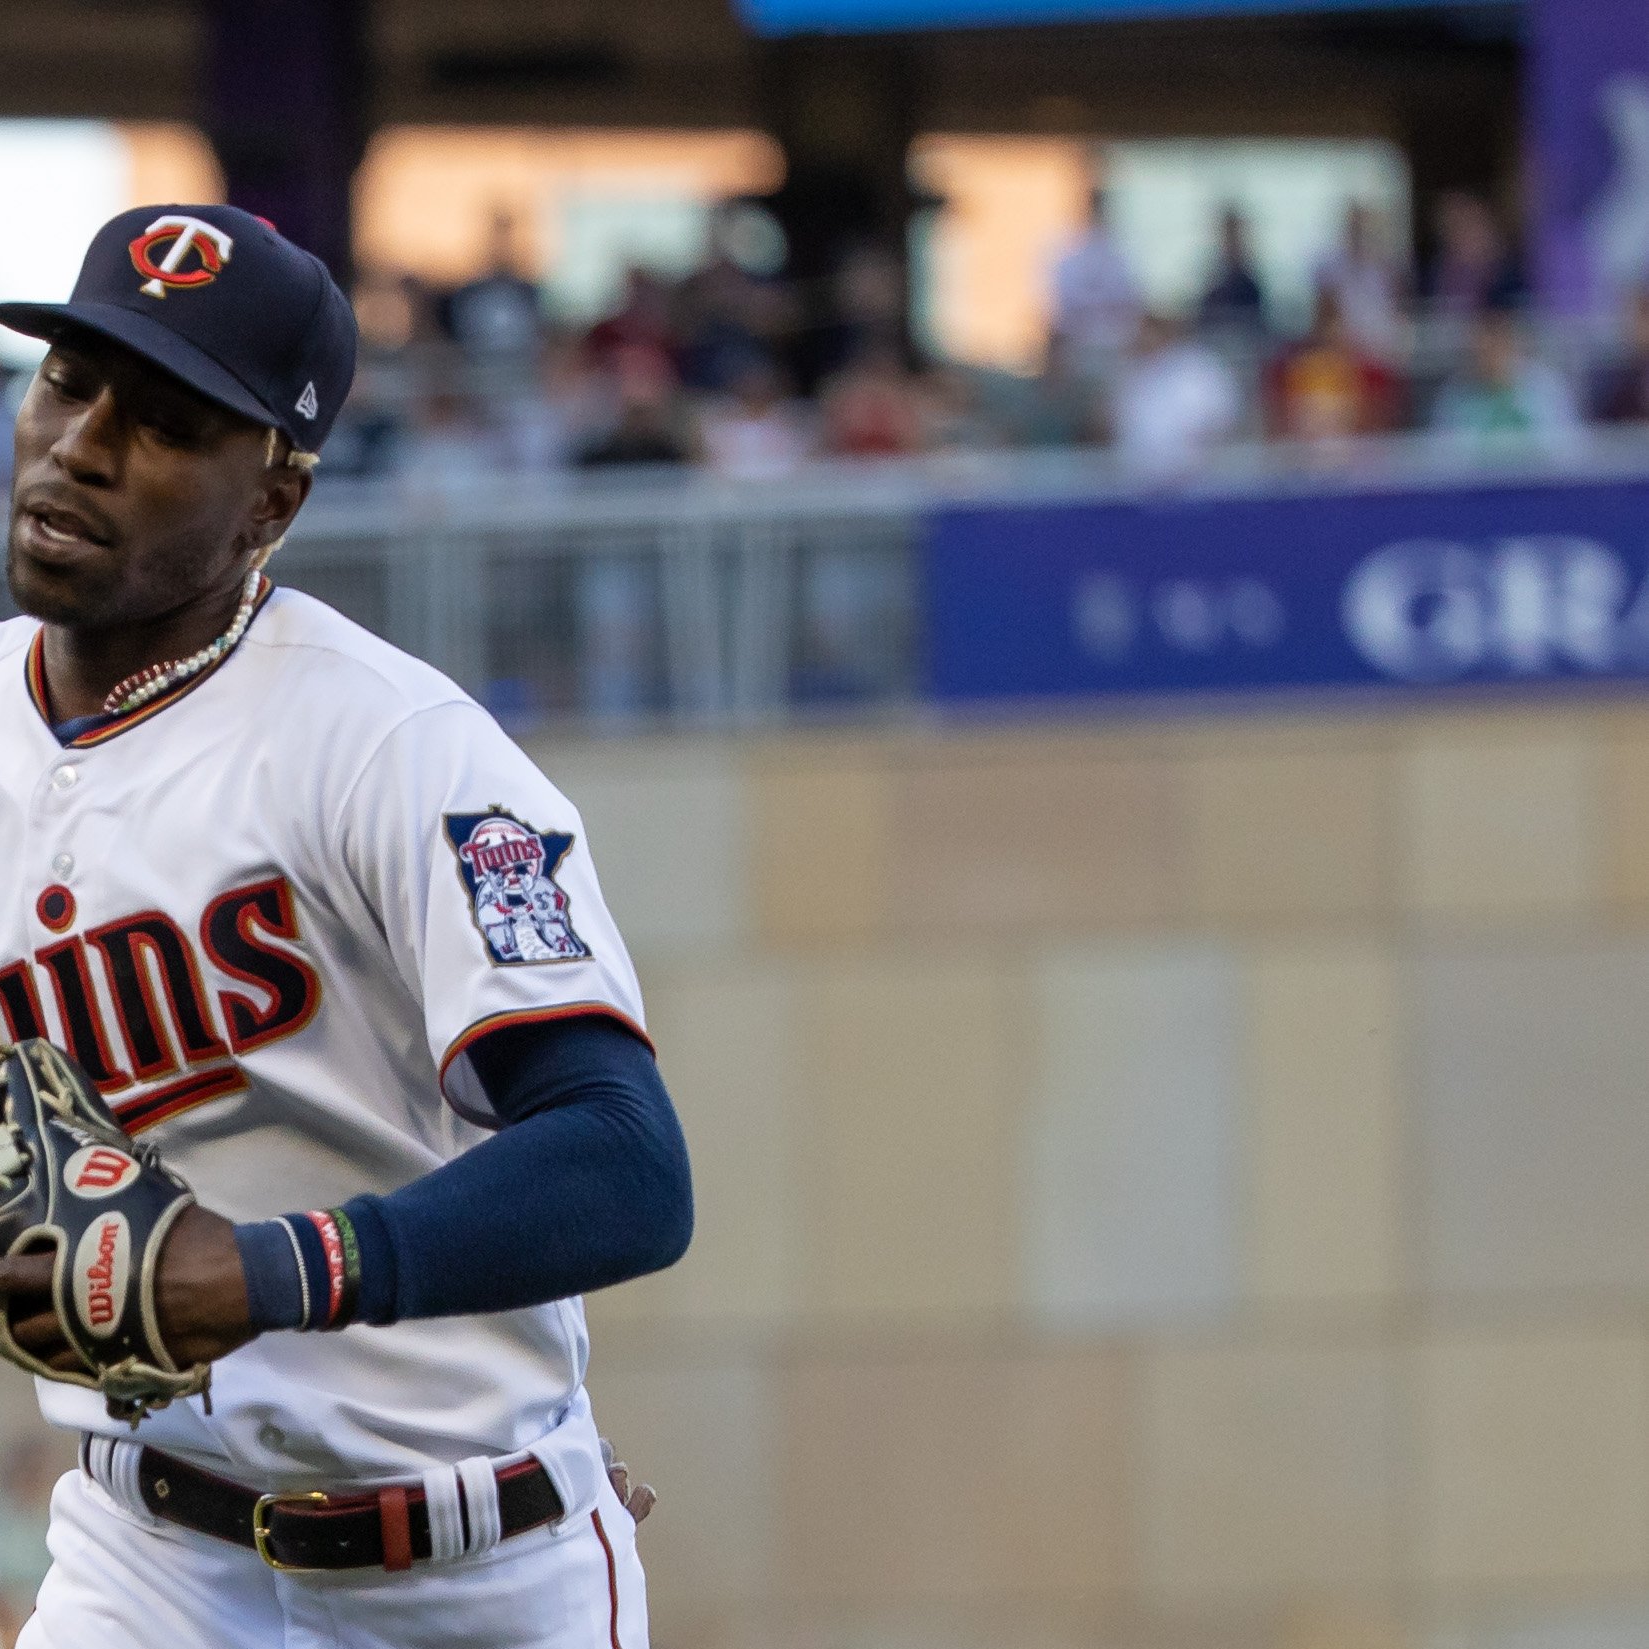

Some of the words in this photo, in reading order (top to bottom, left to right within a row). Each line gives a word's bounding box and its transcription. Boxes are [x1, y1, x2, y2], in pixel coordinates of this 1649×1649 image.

[1342, 535, 1649, 684] GR
[459, 835, 544, 880] Twins
[86, 1221, 122, 1327] Wilson
